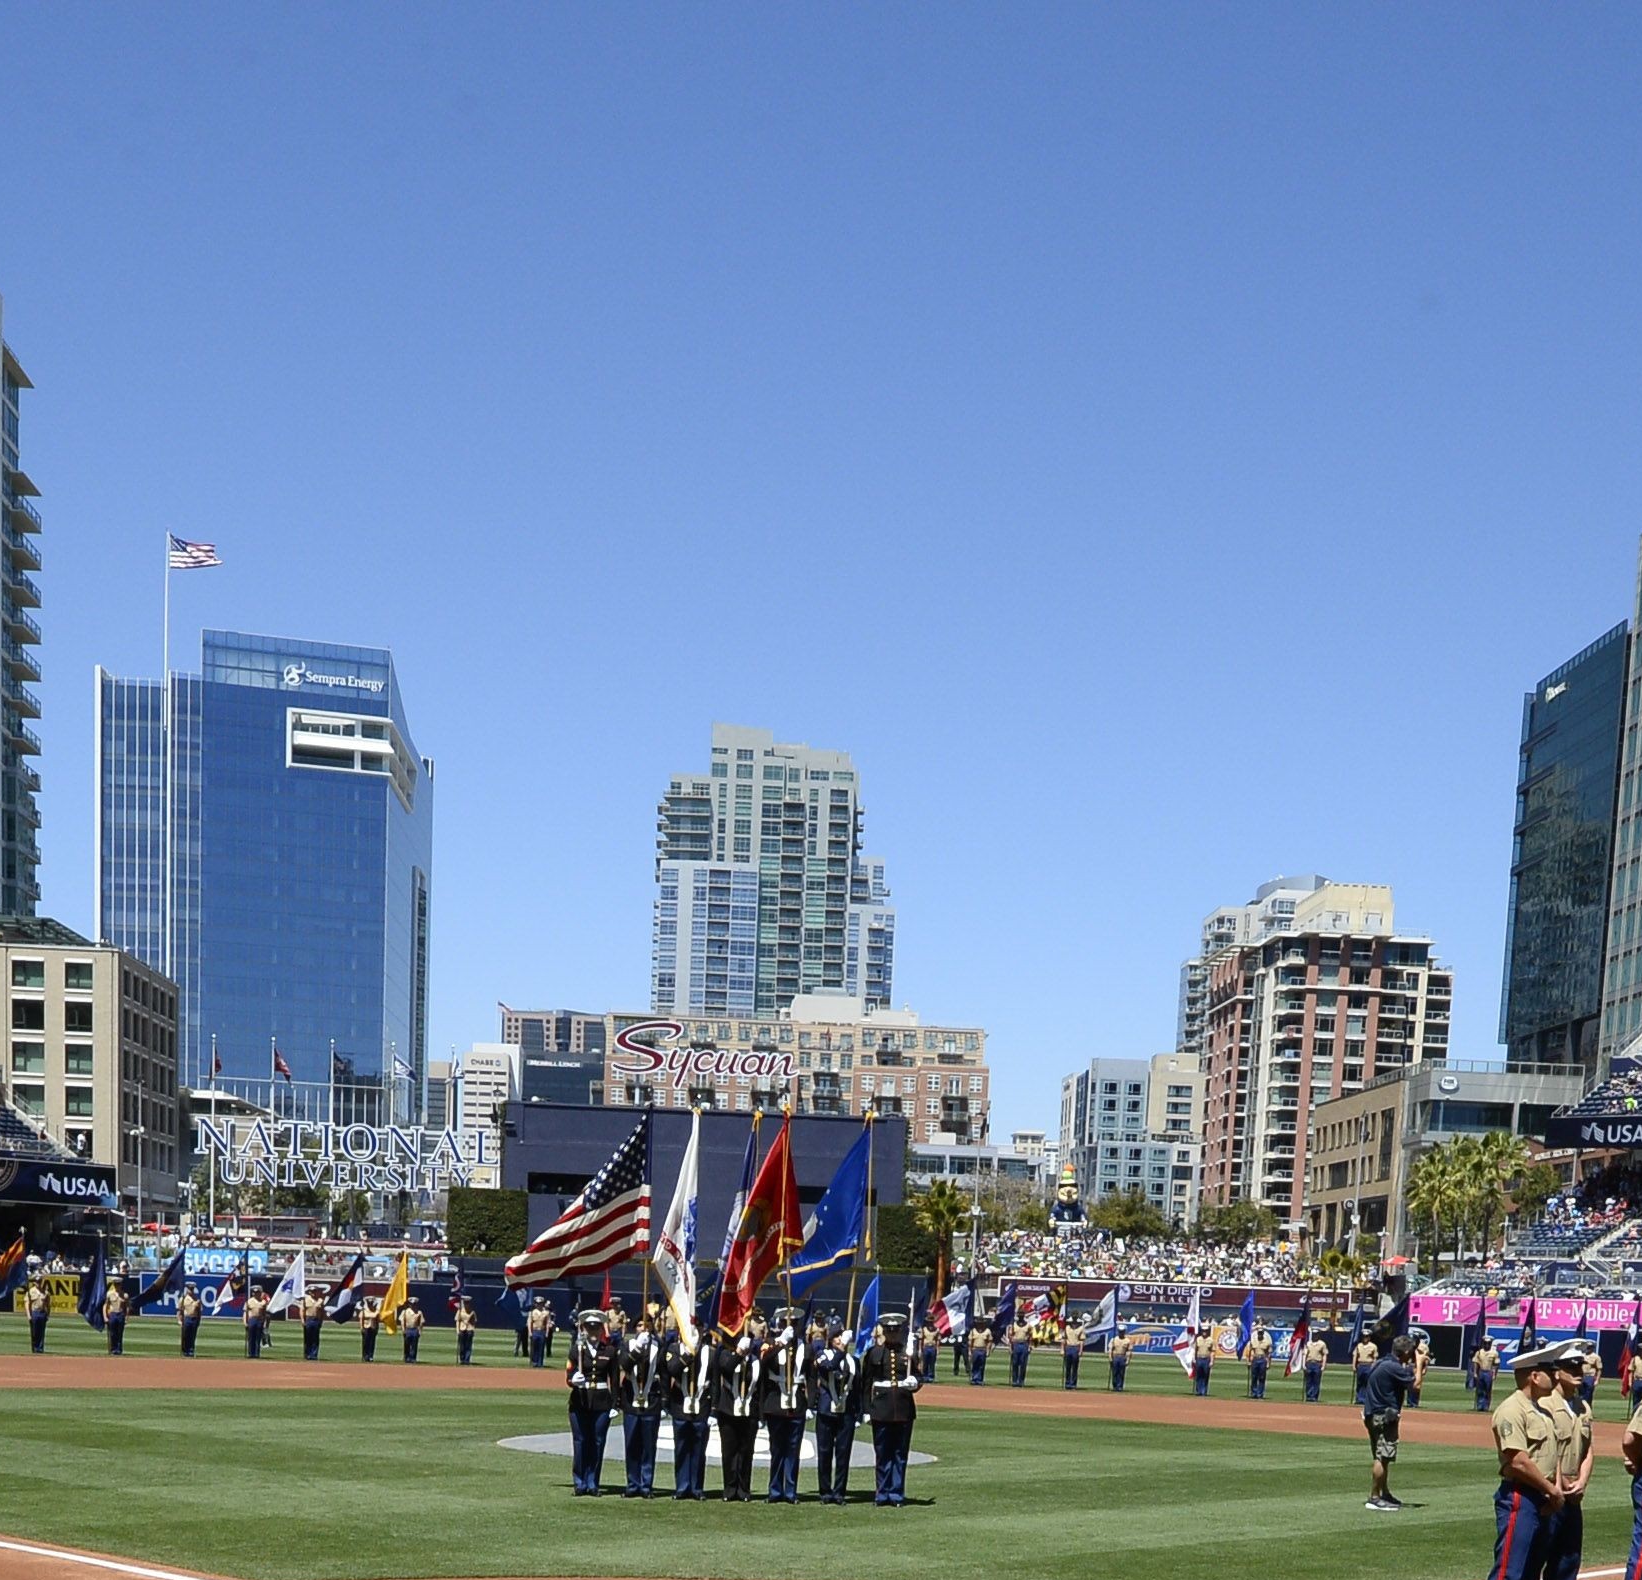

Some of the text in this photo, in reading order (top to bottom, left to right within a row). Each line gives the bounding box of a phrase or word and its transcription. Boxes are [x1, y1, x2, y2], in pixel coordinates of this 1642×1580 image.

[305, 671, 385, 692] Sempra Energy
[471, 1058, 493, 1066] CHASE
[612, 1021, 799, 1089] Sycuan
[194, 1116, 500, 1166] NATIONAL
[219, 1156, 475, 1193] UNIVERSITY
[63, 1176, 109, 1198] USAA
[1133, 1285, 1164, 1296] SUN
